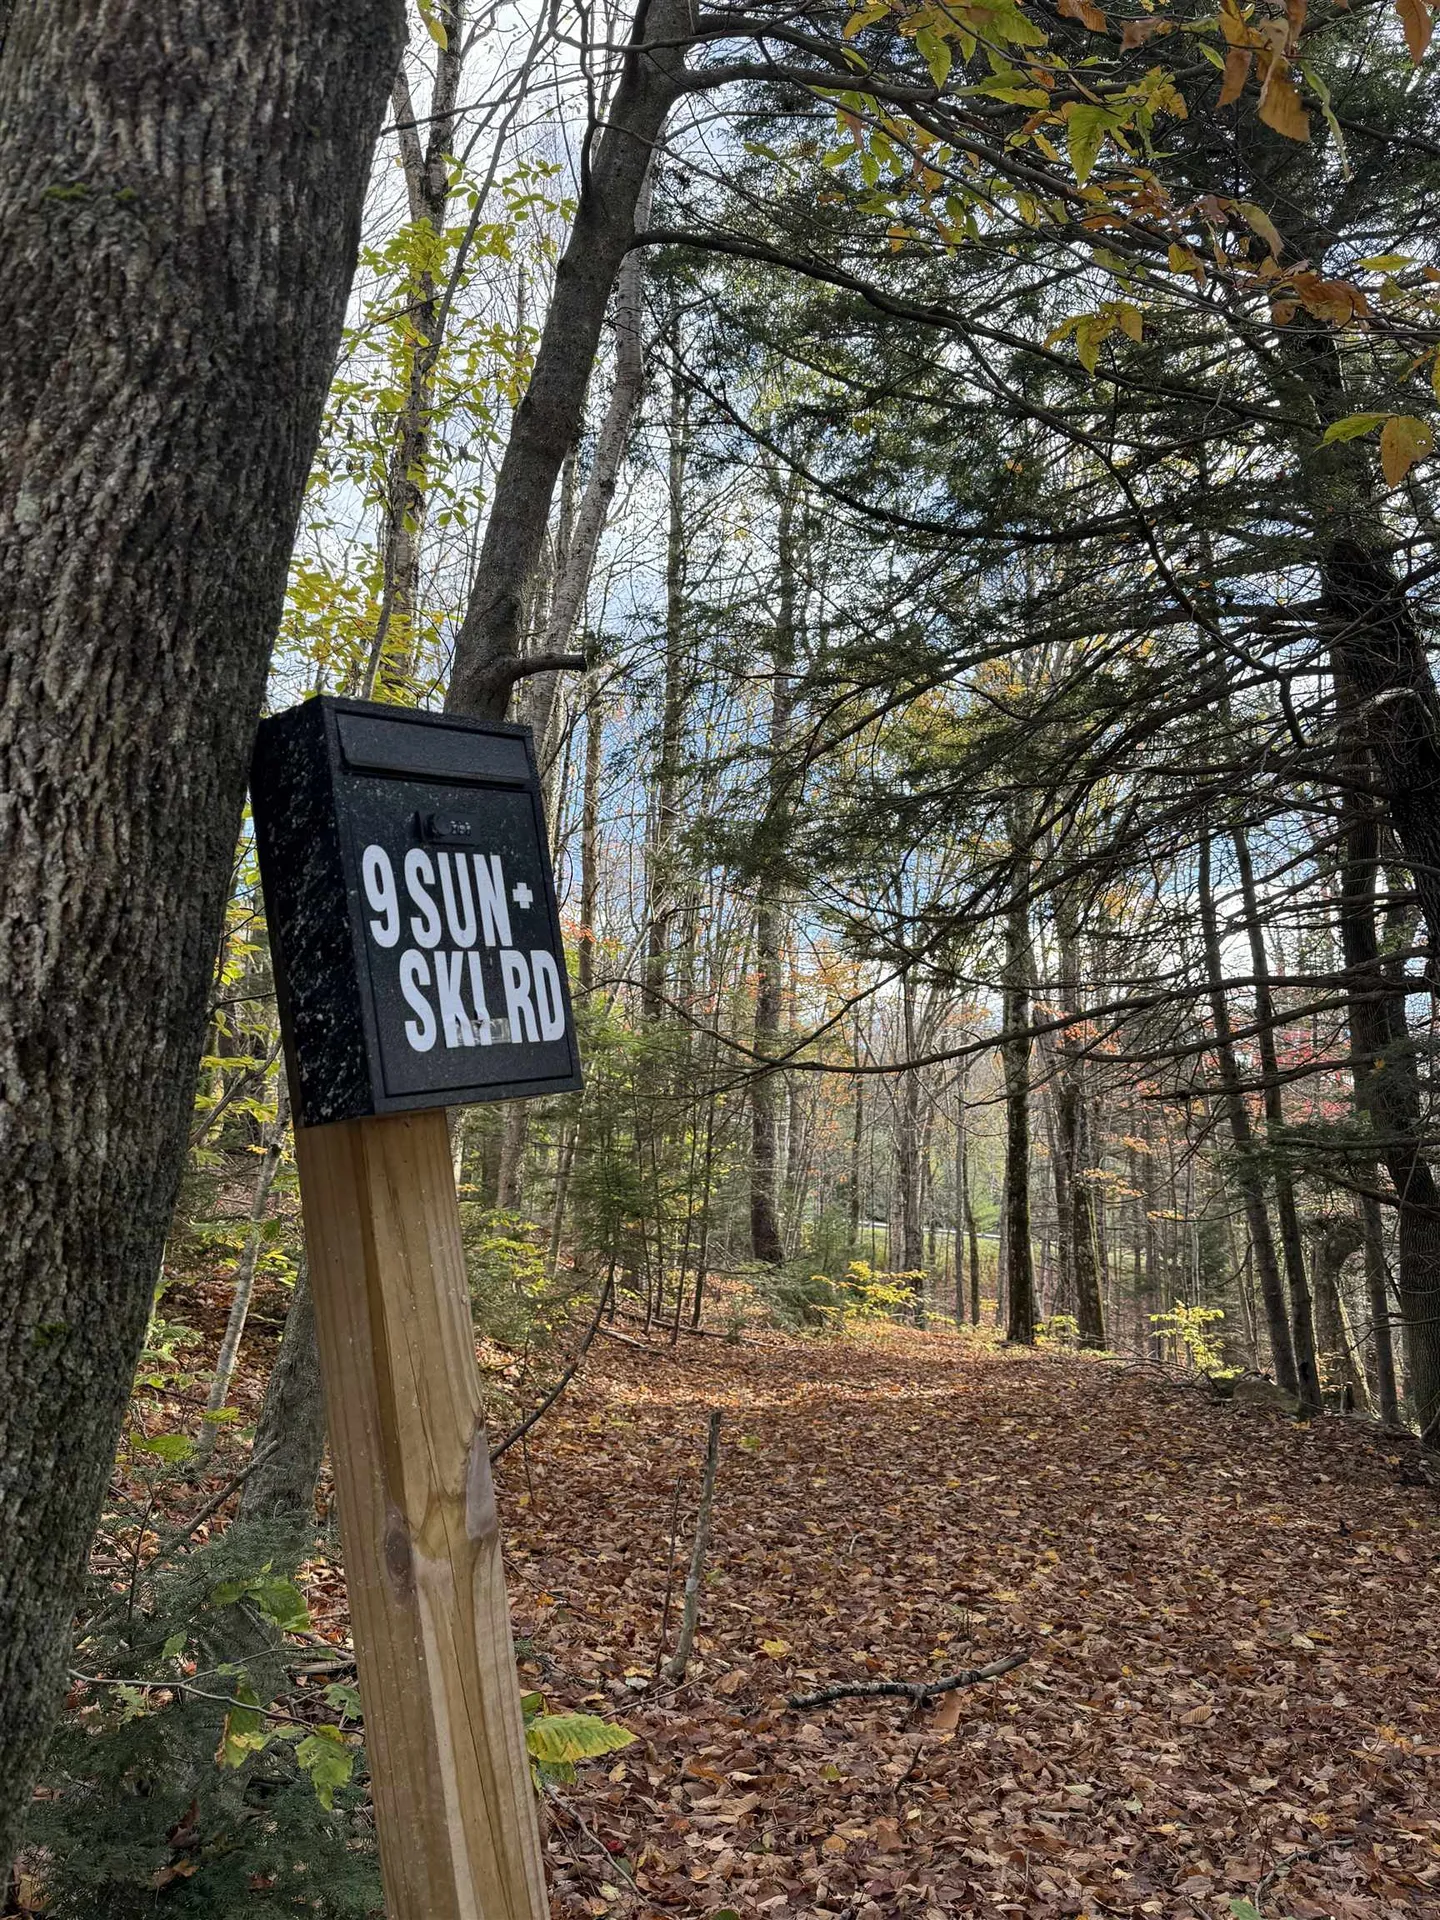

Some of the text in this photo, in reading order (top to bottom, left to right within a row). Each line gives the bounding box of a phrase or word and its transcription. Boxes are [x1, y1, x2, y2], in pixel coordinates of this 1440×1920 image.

[362, 844, 400, 948] 9
[399, 948, 566, 1053] SKI RD
